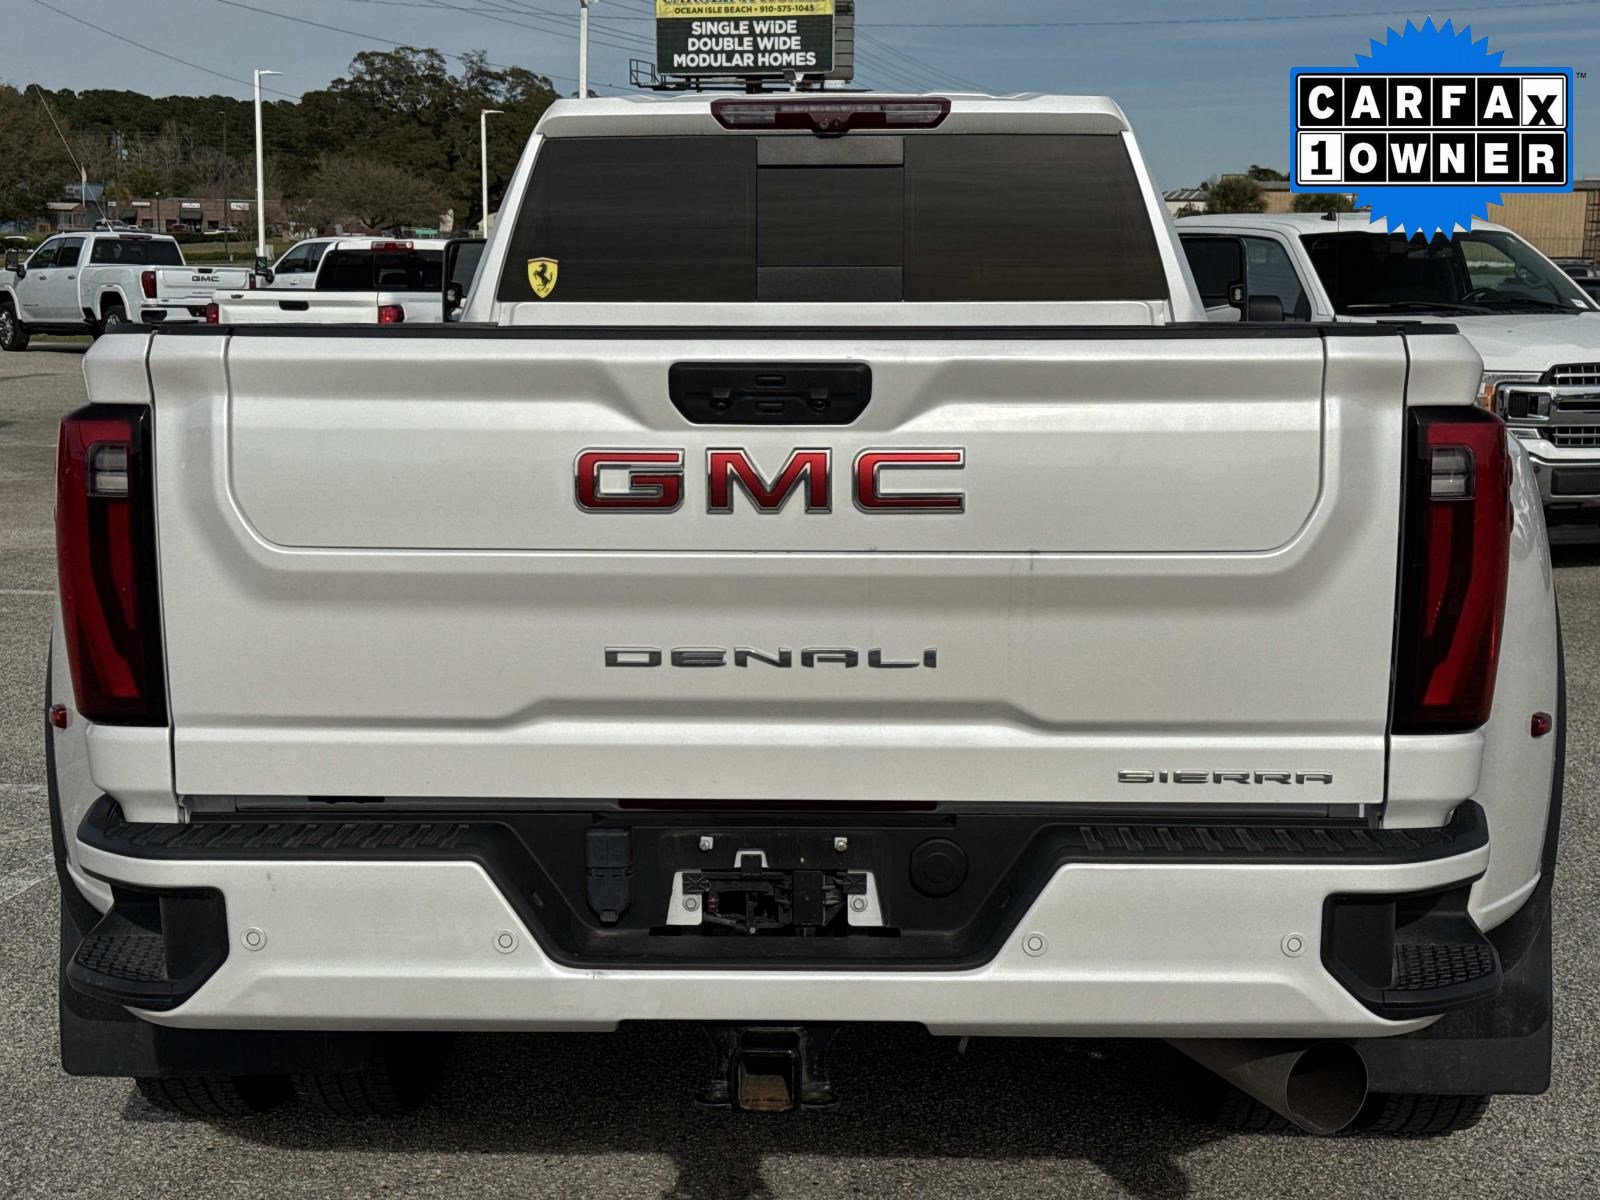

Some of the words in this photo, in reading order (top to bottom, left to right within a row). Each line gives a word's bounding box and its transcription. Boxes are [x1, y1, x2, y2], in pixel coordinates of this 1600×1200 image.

[705, 6, 722, 14] ISLE
[691, 20, 750, 35] SINGLE
[752, 19, 798, 35] WIDE
[687, 37, 754, 51] DOUBLE
[756, 36, 802, 50] WIDE
[673, 53, 755, 67] MODULAR
[757, 52, 817, 66] HOMES
[573, 446, 966, 515] GMC
[604, 645, 938, 670] DENALI
[1117, 769, 1334, 785] SIERRA
